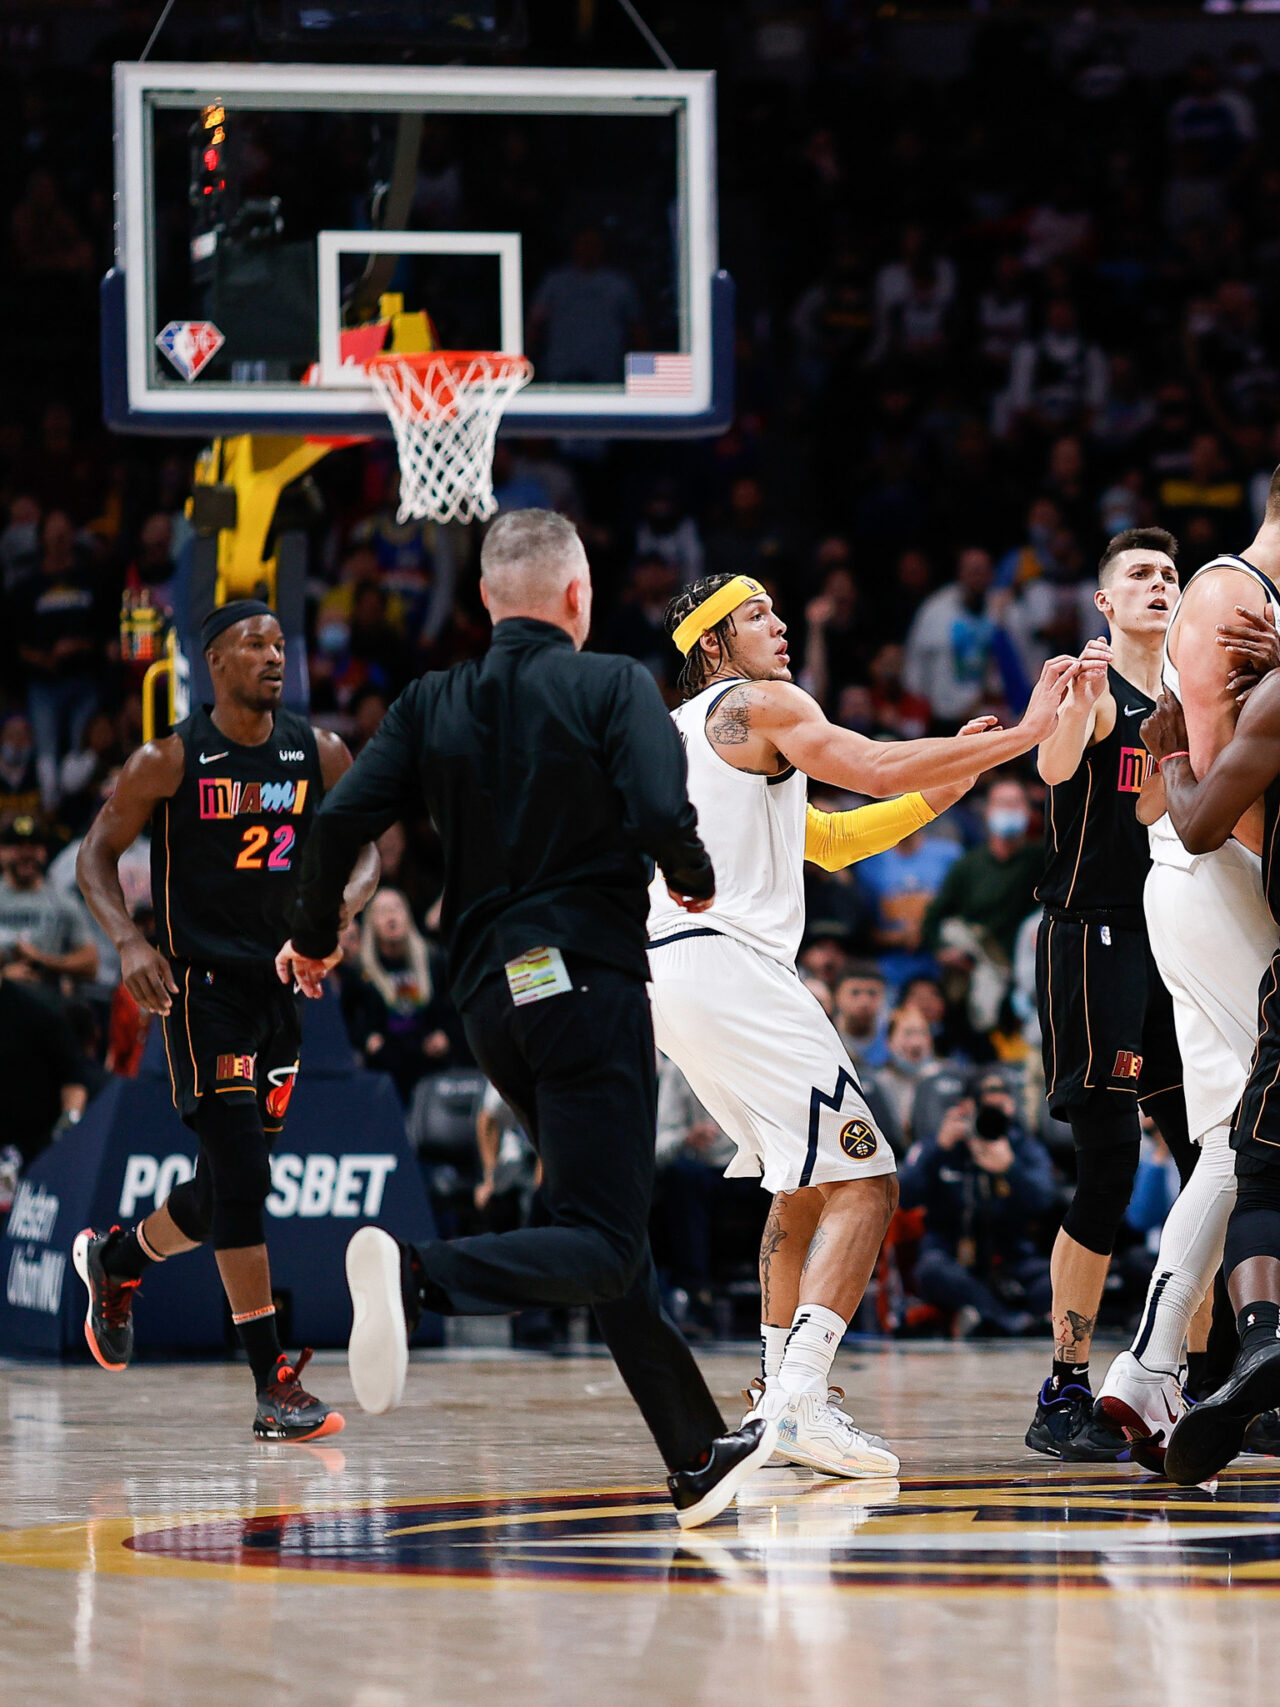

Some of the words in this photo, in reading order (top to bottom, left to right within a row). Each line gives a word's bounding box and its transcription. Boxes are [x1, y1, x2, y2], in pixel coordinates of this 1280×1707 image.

[279, 750, 305, 761] UKG
[199, 778, 309, 819] MIAMI
[235, 825, 296, 872] 22
[118, 1153, 399, 1219] POSBET
